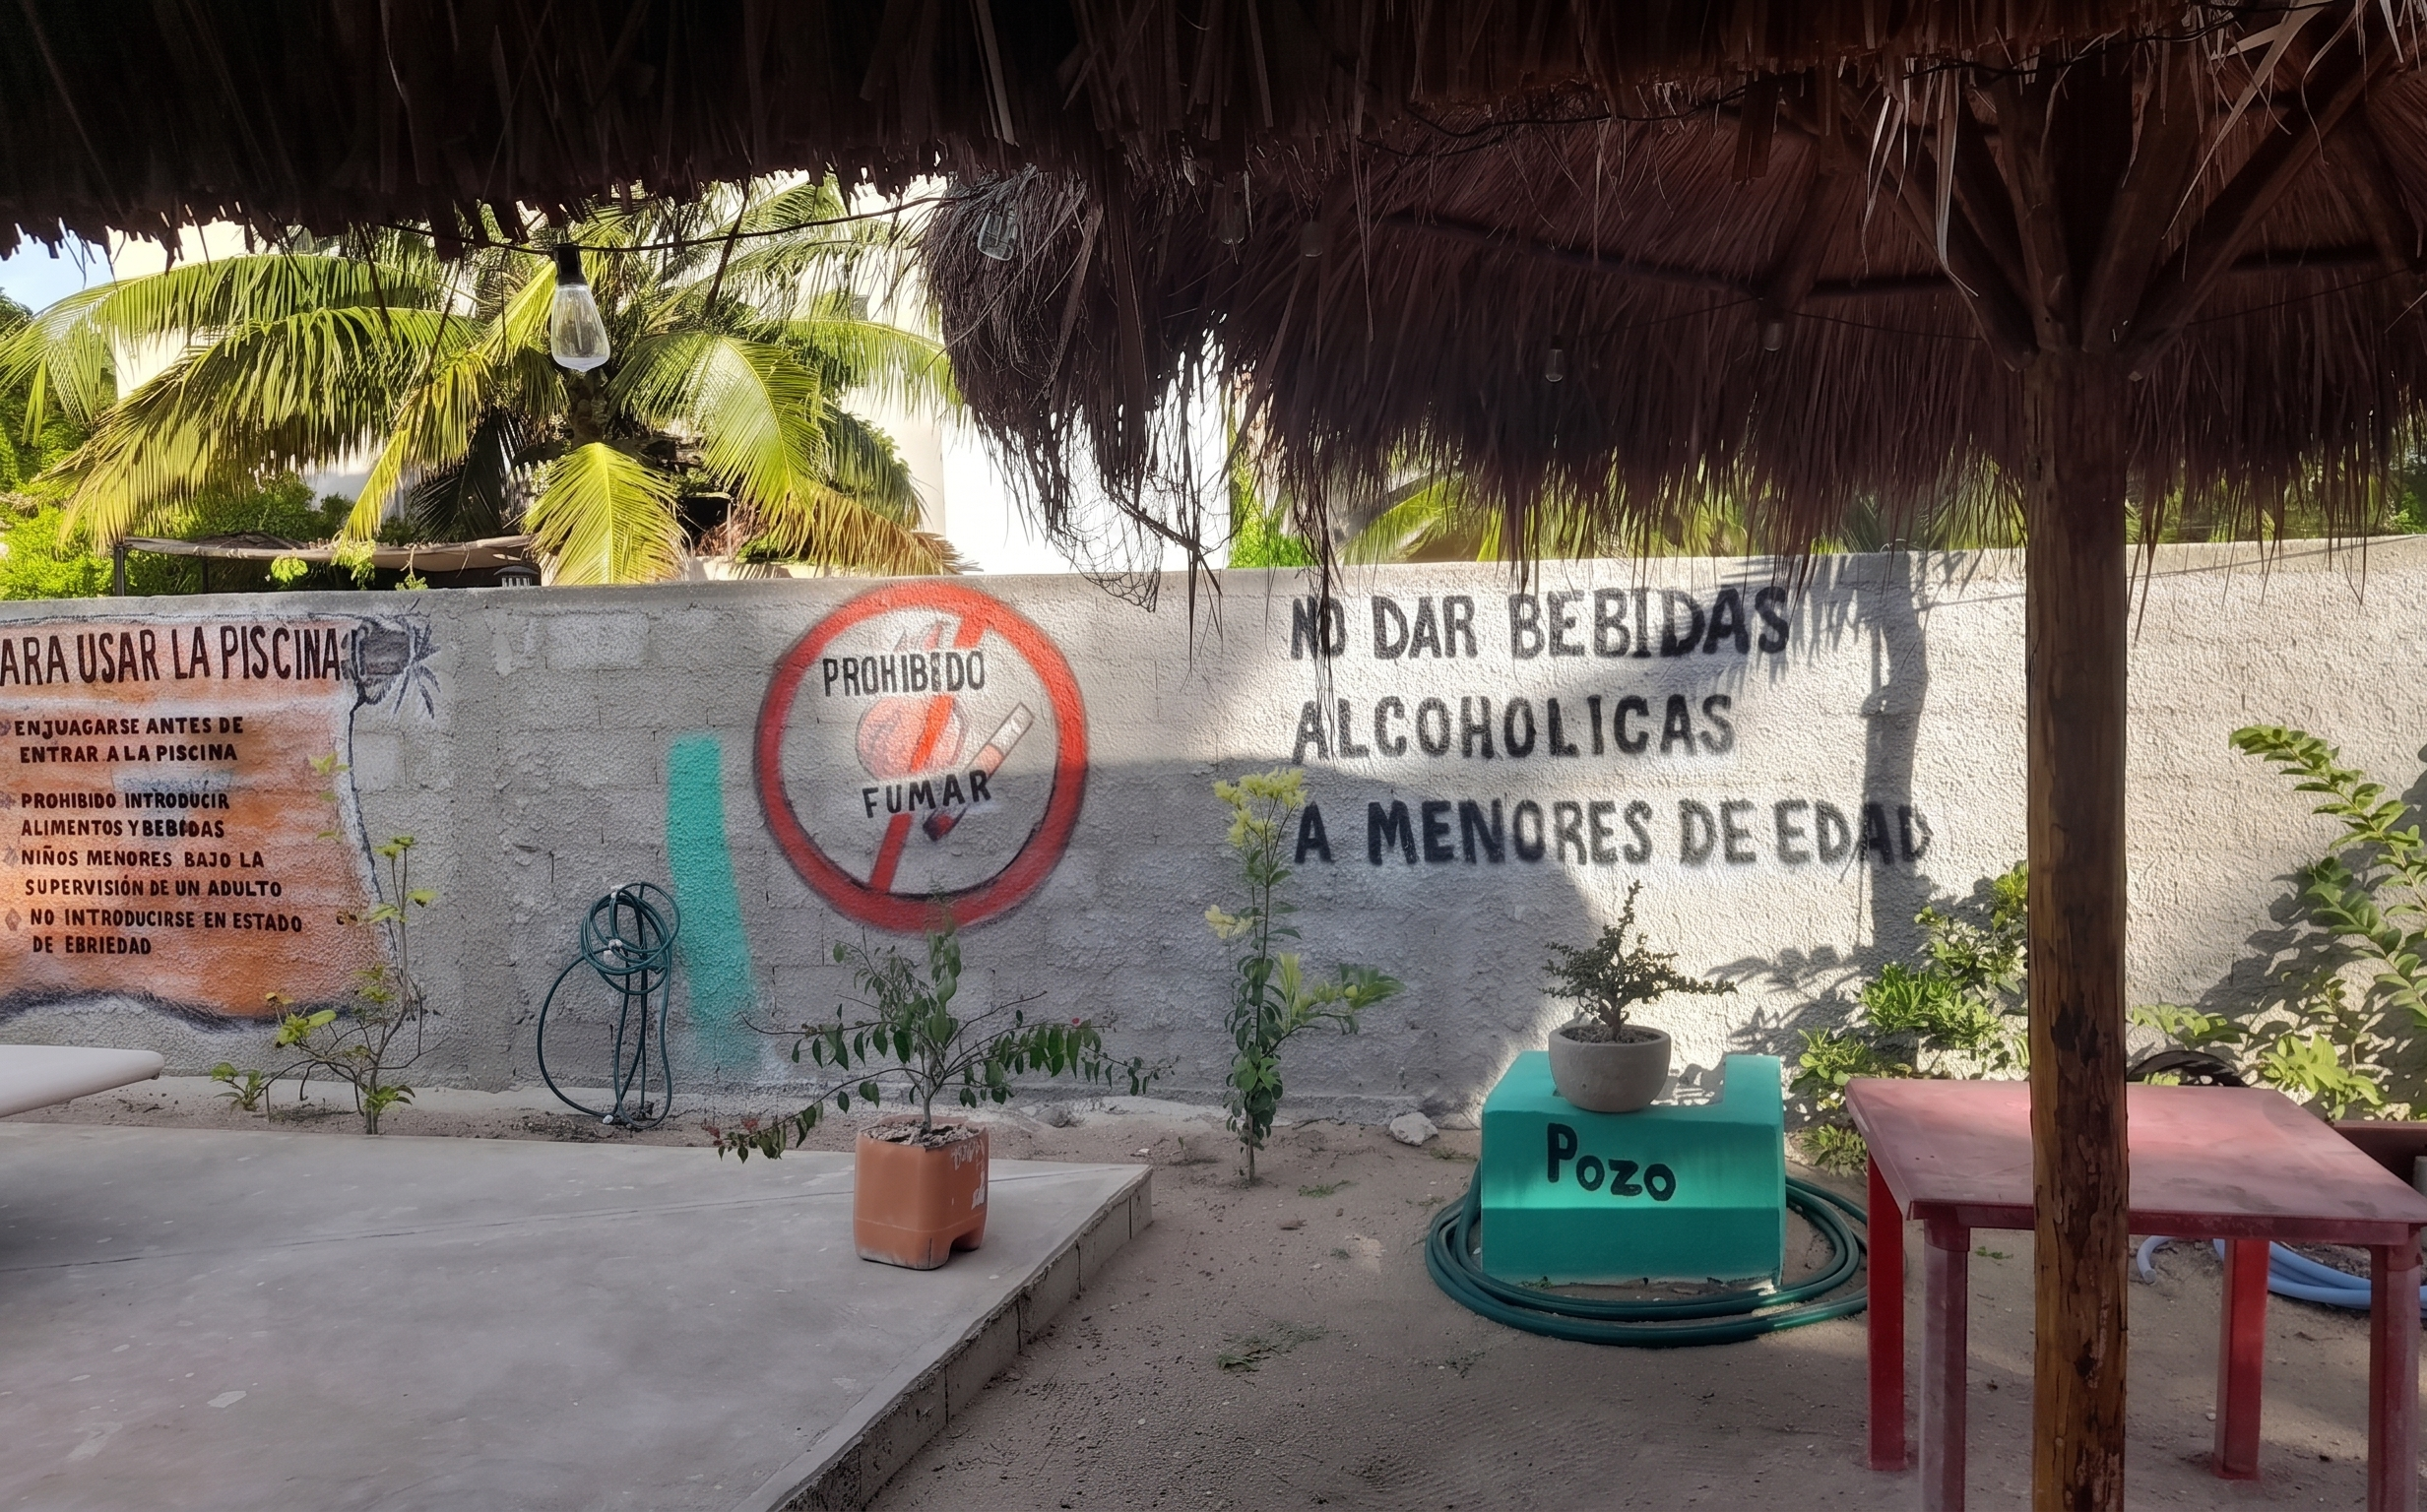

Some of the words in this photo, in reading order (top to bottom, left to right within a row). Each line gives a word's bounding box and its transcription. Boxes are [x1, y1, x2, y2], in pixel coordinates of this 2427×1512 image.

[1290, 596, 1346, 660] NO
[1371, 595, 1478, 660] DAR
[1507, 586, 1790, 660] BEBIDAS
[77, 629, 160, 683] USAR
[171, 626, 211, 679] LA
[220, 625, 342, 681] PISCINA
[822, 651, 986, 697] PROHIBIDO
[15, 719, 139, 739] ENJUAGARSE
[146, 718, 212, 734] ANTES
[220, 717, 243, 734] DE
[1291, 692, 1735, 764] ALCOHOLICAS
[20, 746, 98, 763] ENTRAR
[106, 745, 119, 762] A
[124, 745, 151, 762] LA
[156, 744, 237, 761] PISCINA
[21, 792, 116, 809] PROHIBIDO
[125, 792, 229, 809] INTRODUCIR
[862, 770, 991, 818] FUMAR
[21, 820, 123, 837] ALIMENTOS
[127, 820, 140, 836] Y
[143, 819, 224, 838] BEBIDAS
[1294, 801, 1334, 866] A
[1366, 797, 1654, 866] MENORES
[1678, 798, 1757, 866] DE
[1774, 798, 1934, 866] EDAD
[21, 845, 79, 867] NIÑOS
[87, 850, 172, 867] MENORES
[184, 850, 231, 868] BAJO
[239, 851, 265, 868] LA
[25, 874, 144, 897] SUPERVISIÓN
[150, 879, 169, 896] DE
[175, 879, 200, 897] UN
[208, 879, 282, 898] ADULTO
[31, 908, 55, 926] NO
[64, 909, 195, 928] INTRODUCIRSE
[204, 912, 226, 928] EN
[232, 913, 302, 932] ESTADO
[32, 936, 53, 954] DE
[65, 936, 152, 955] EBRIEDAD
